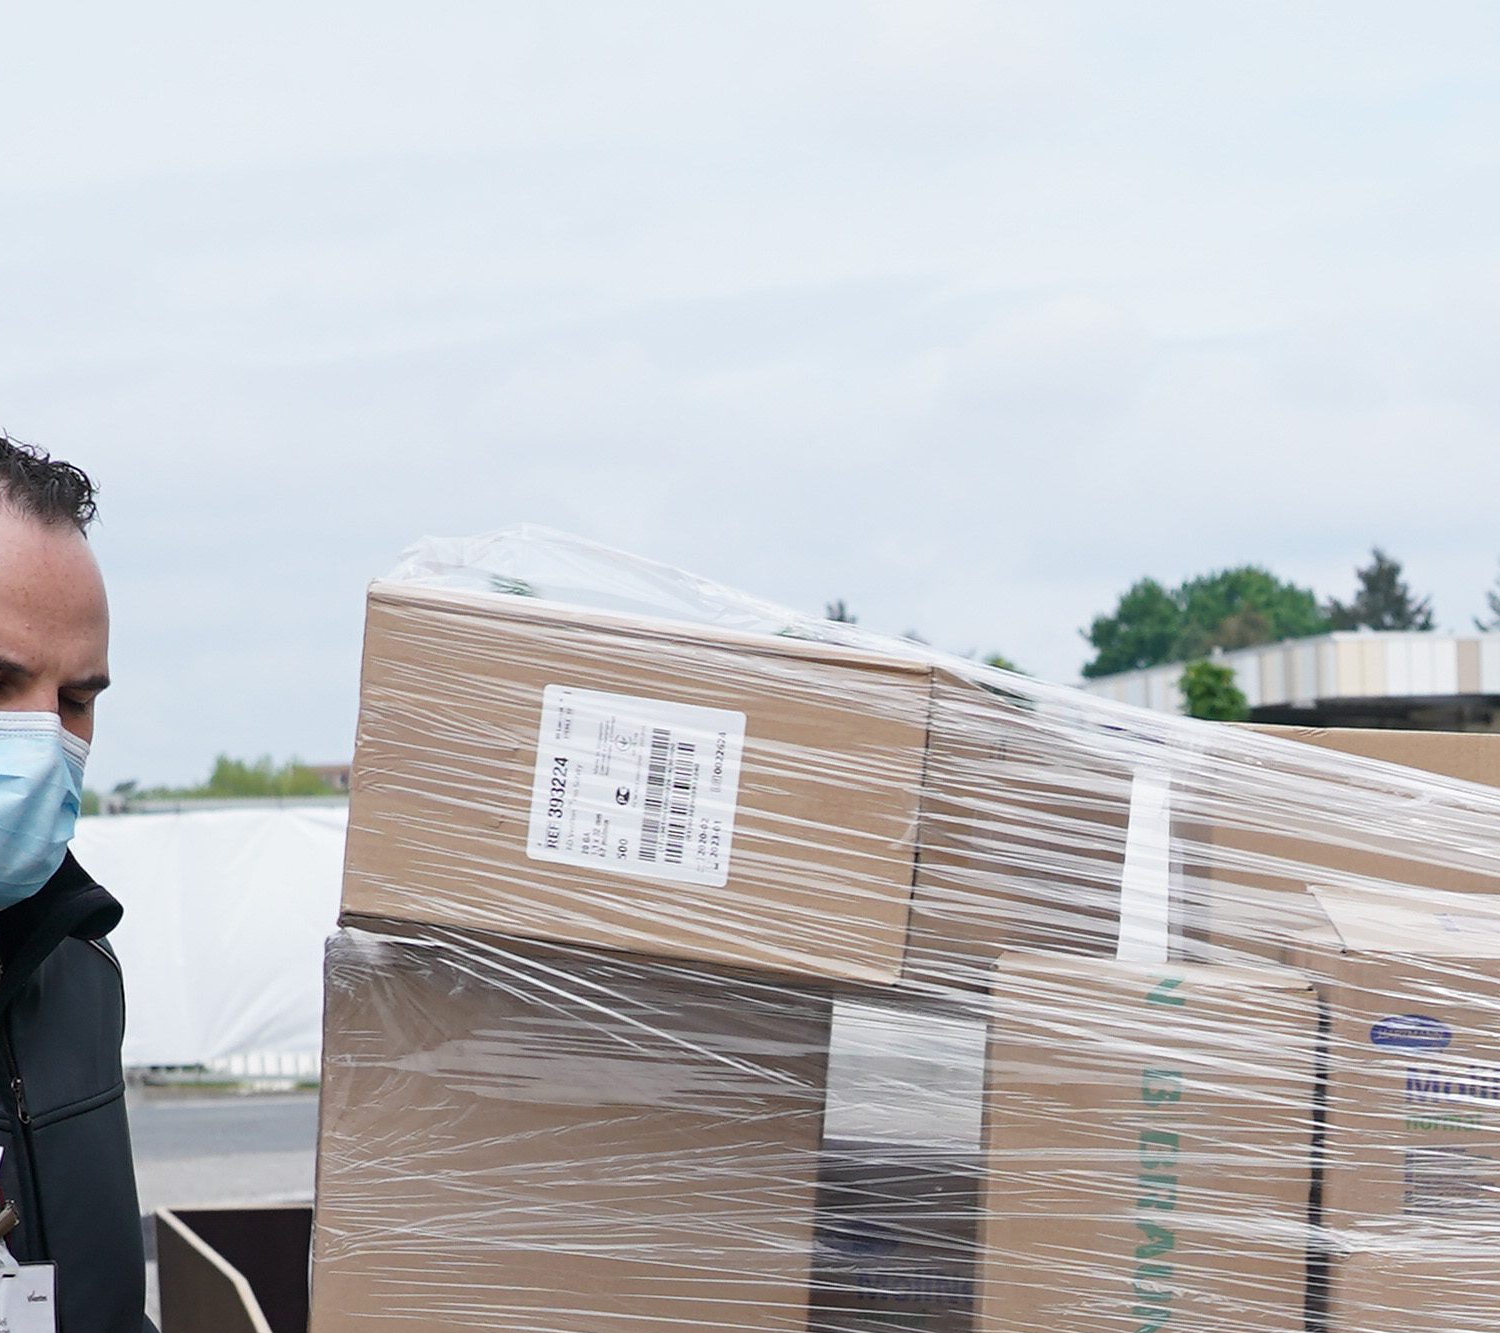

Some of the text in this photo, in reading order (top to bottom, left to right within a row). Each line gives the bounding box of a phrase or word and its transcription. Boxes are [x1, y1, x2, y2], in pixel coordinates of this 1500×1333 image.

[548, 756, 570, 819] 393224
[546, 824, 561, 849] REF
[617, 838, 629, 860] 500
